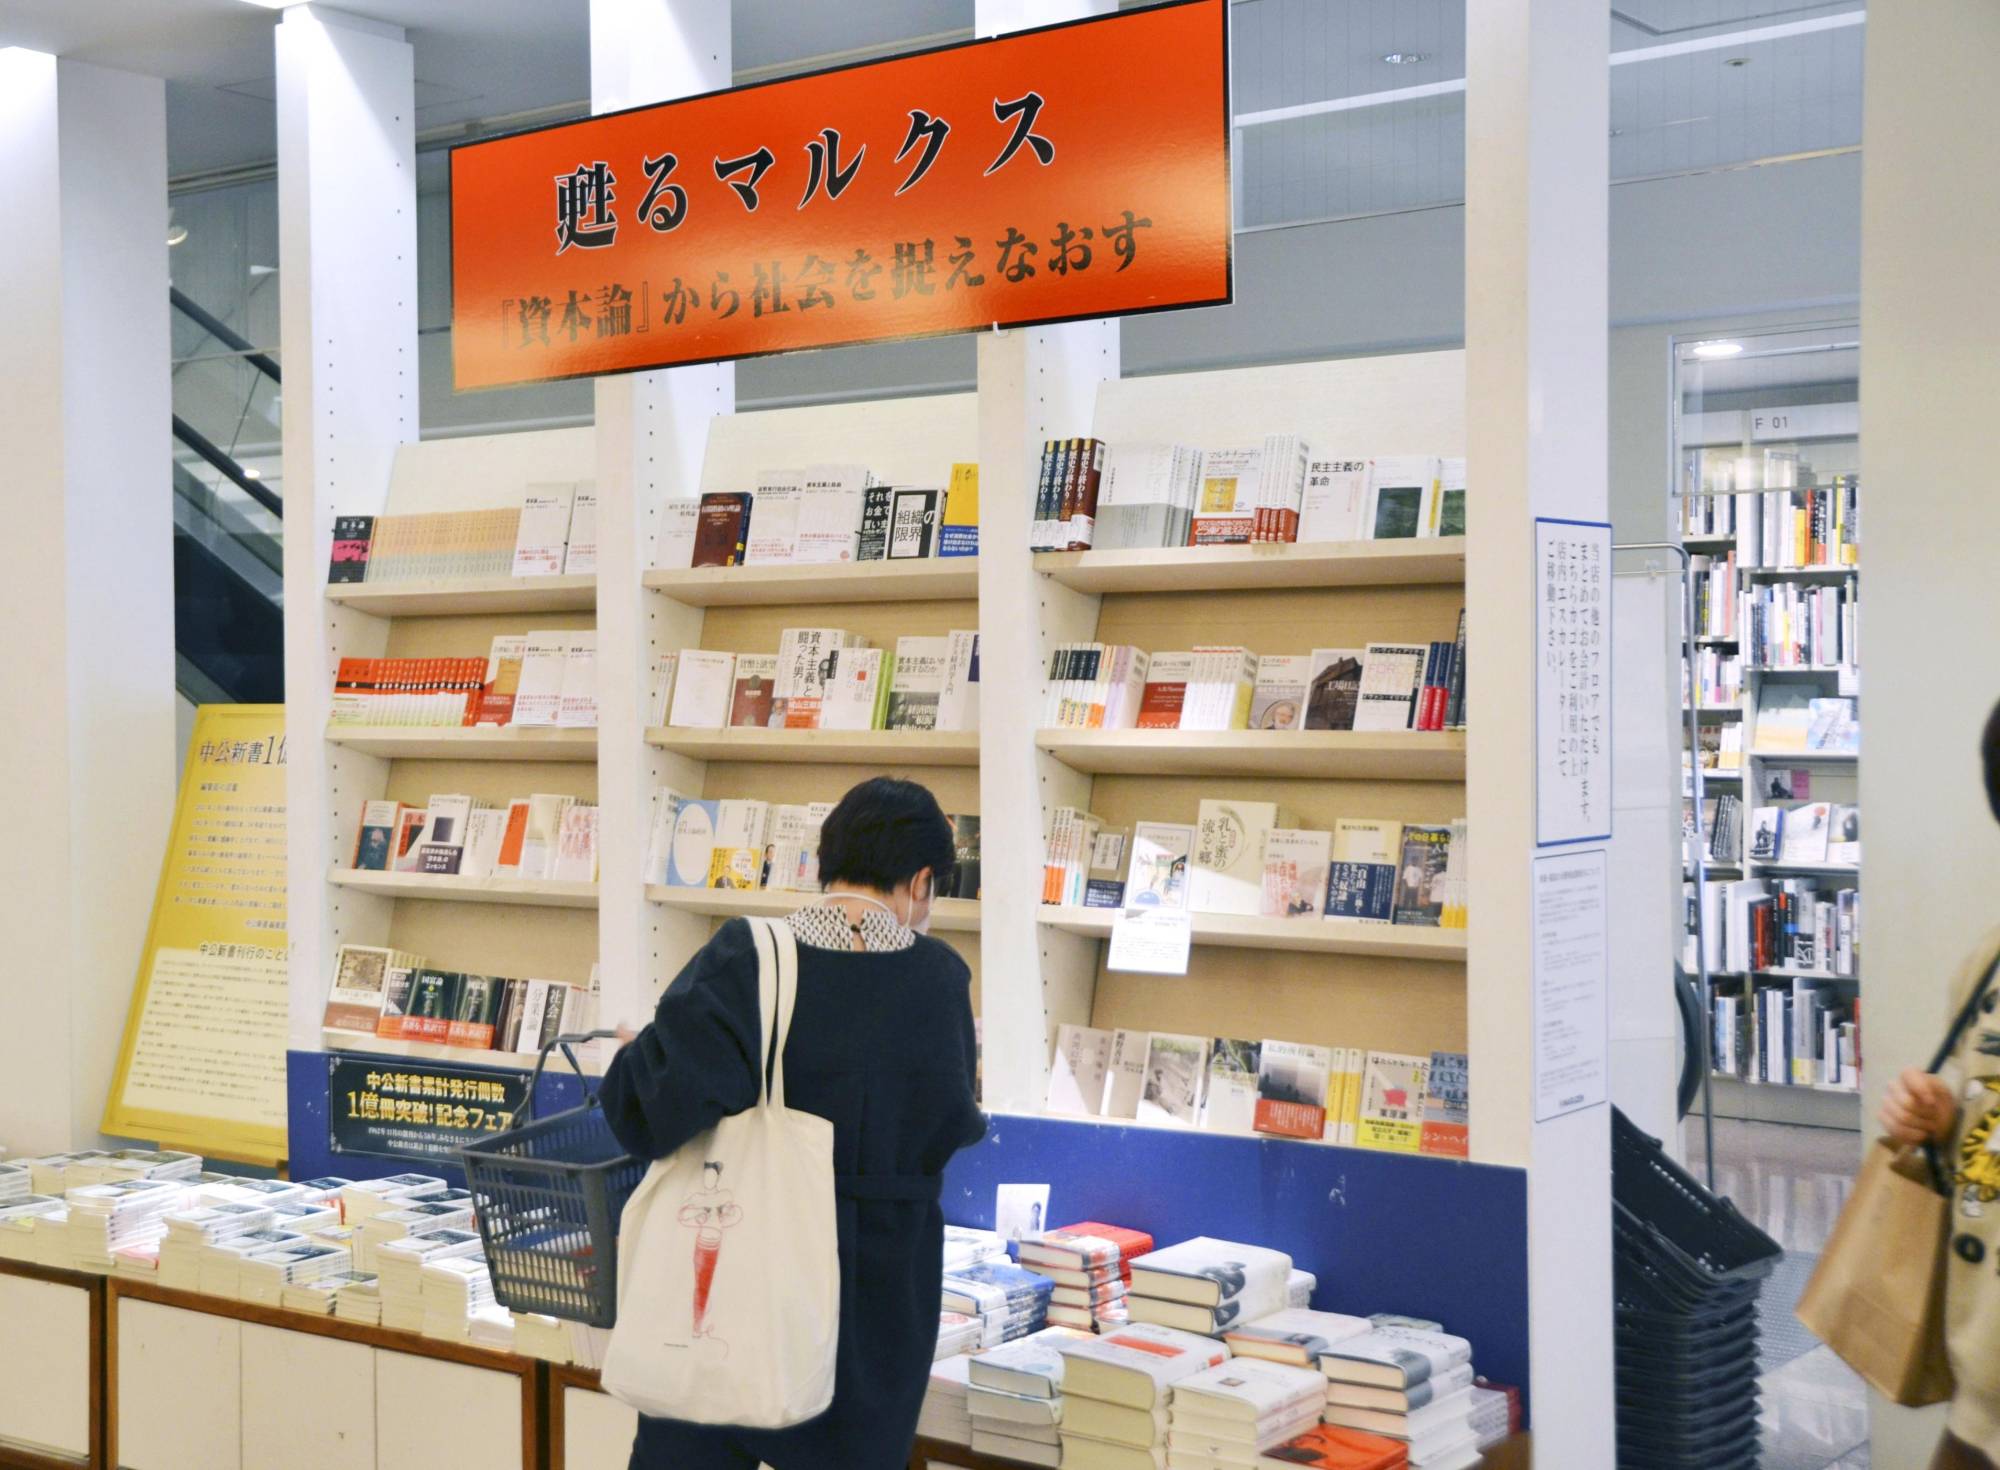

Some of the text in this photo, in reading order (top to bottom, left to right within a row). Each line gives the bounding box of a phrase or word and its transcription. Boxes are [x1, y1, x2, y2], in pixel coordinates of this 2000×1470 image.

[555, 91, 1055, 255] 甦るマルクス
[499, 209, 1153, 350] 『資本論』から社会を捉えなおす
[1755, 416, 1788, 430] F 01
[1311, 462, 1365, 473] 民主主義の
[1309, 476, 1331, 487] 革命
[868, 491, 892, 503] それを
[866, 505, 890, 516] お金で
[897, 509, 937, 526] 組織の
[895, 526, 922, 543] 限界
[792, 631, 810, 679] 闘った男
[803, 631, 822, 697] 資本主義と
[546, 988, 562, 1018] 社会
[366, 1071, 506, 1104] 中公新書累計発行冊数
